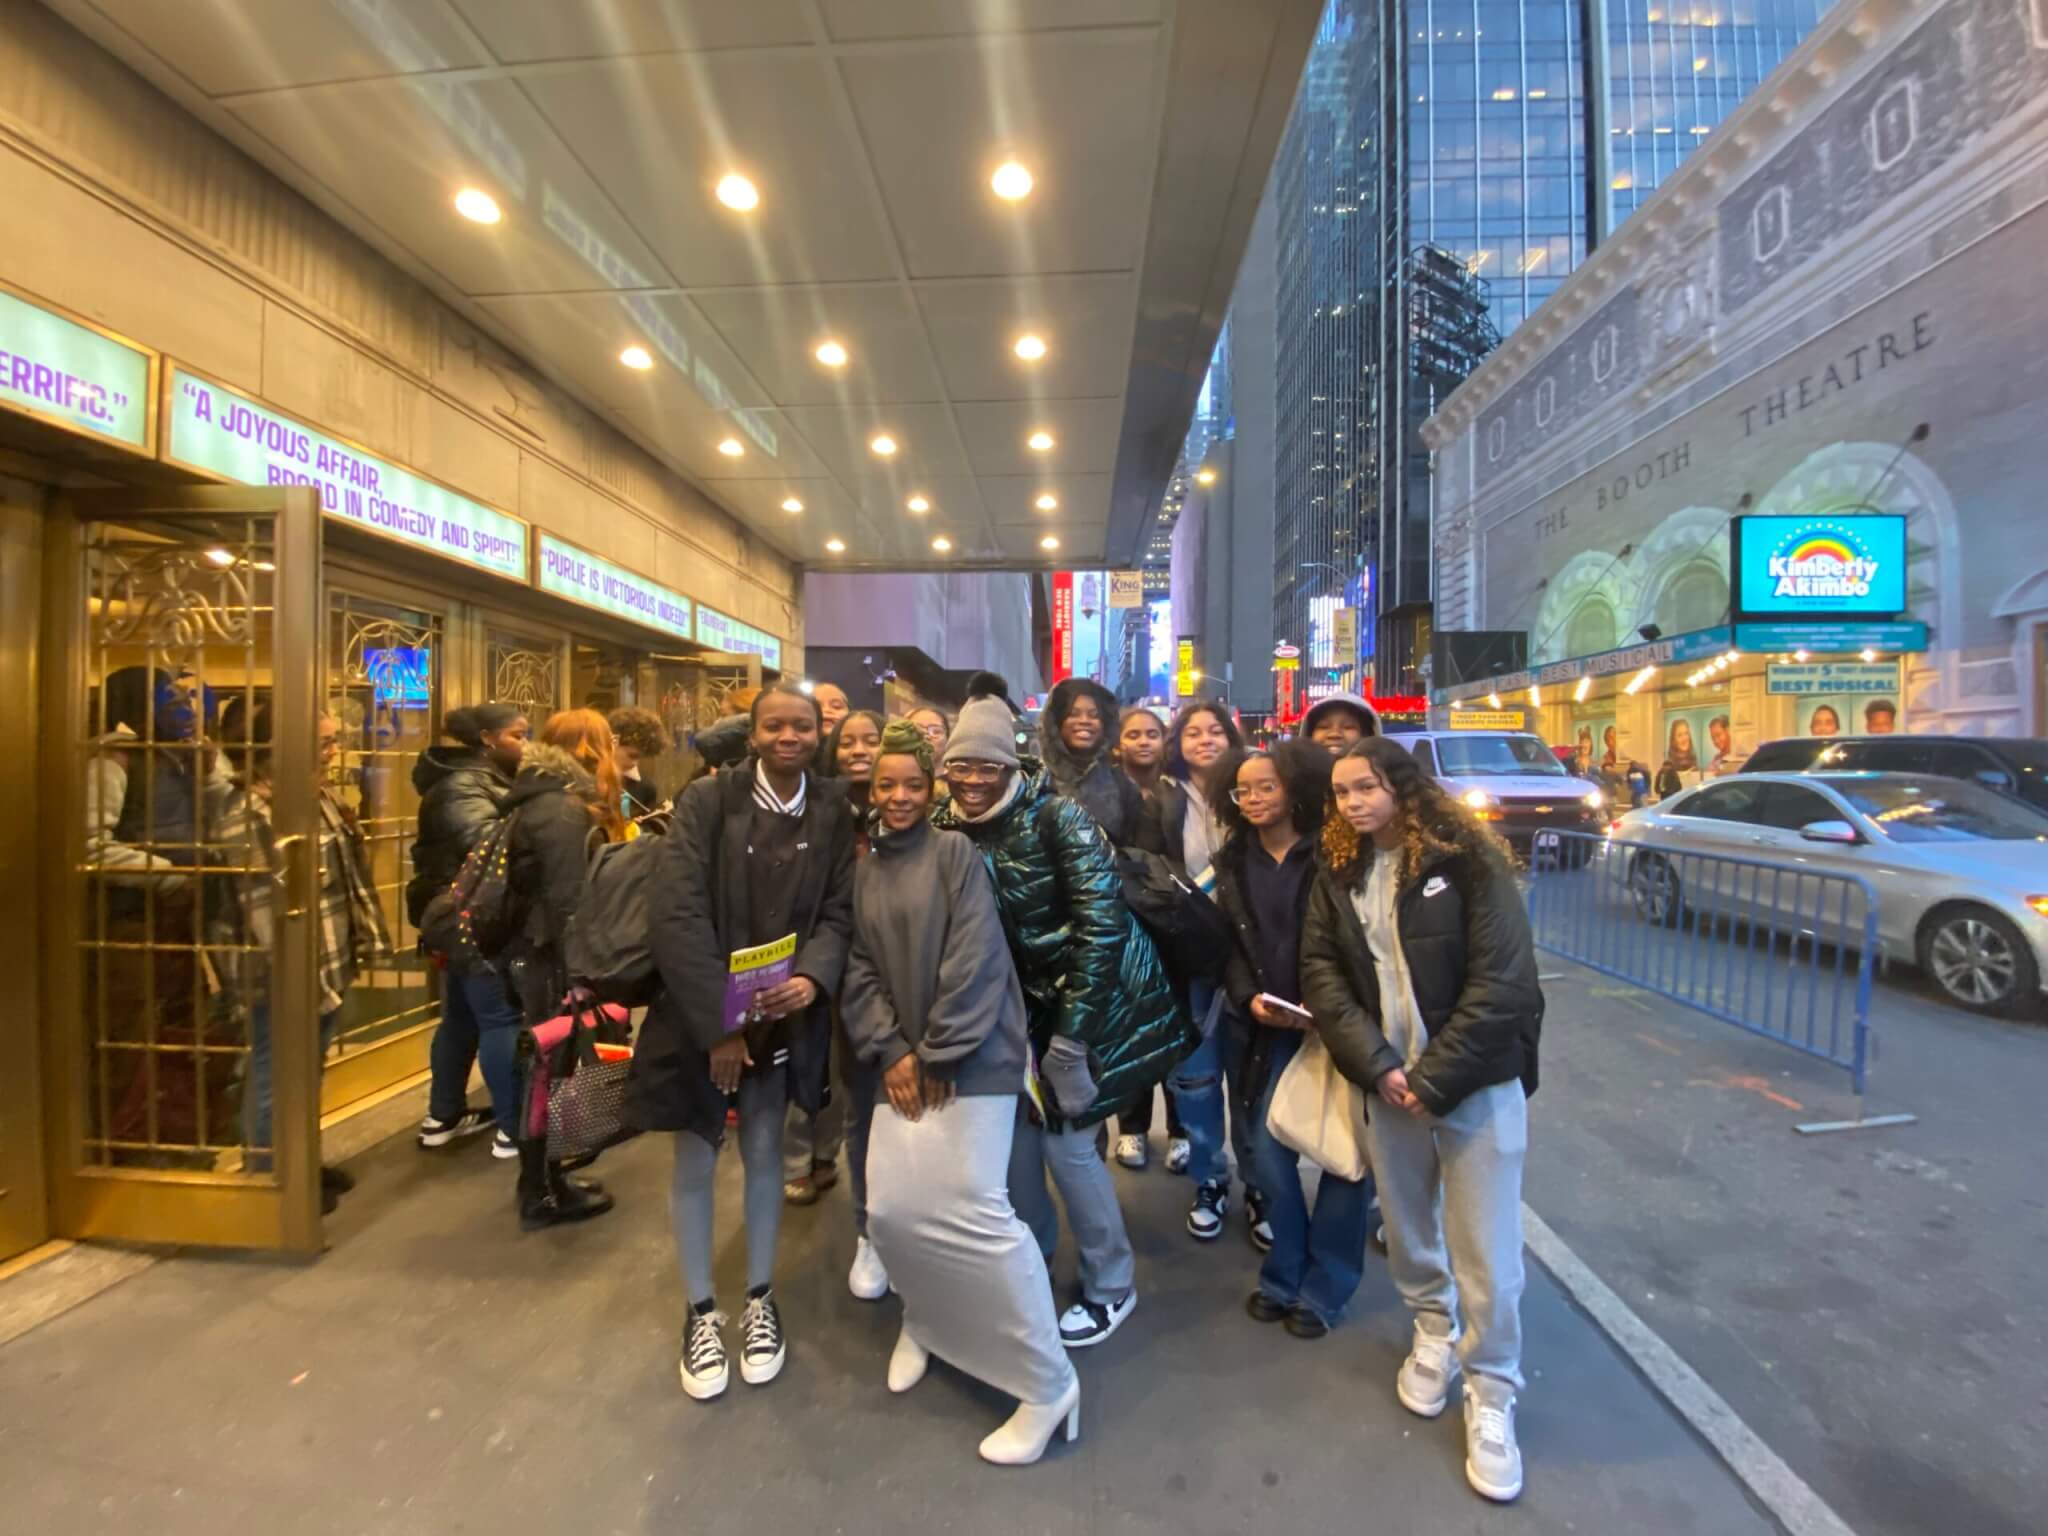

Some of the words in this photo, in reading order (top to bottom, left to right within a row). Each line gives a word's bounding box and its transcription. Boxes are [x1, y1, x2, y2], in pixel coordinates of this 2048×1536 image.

[1533, 504, 1569, 541] THE
[1597, 442, 1692, 513] BOOTH
[1739, 311, 1938, 437] THEATRE
[221, 403, 310, 464] JOYOUS
[316, 443, 383, 499] AFFAIR,
[344, 487, 363, 518] IN
[369, 496, 436, 538] COMEDY
[441, 520, 470, 549] AND
[1769, 556, 1879, 582] Kimberly
[589, 567, 600, 592] IS
[602, 574, 656, 615] VICTORIOUS
[1111, 578, 1140, 593] KING
[1774, 576, 1870, 597] Akimbo
[1541, 666, 1581, 682] BEST
[1770, 680, 1814, 692] BEST
[1818, 680, 1897, 692] MUSICAL
[734, 941, 793, 965] PLAYBILL
